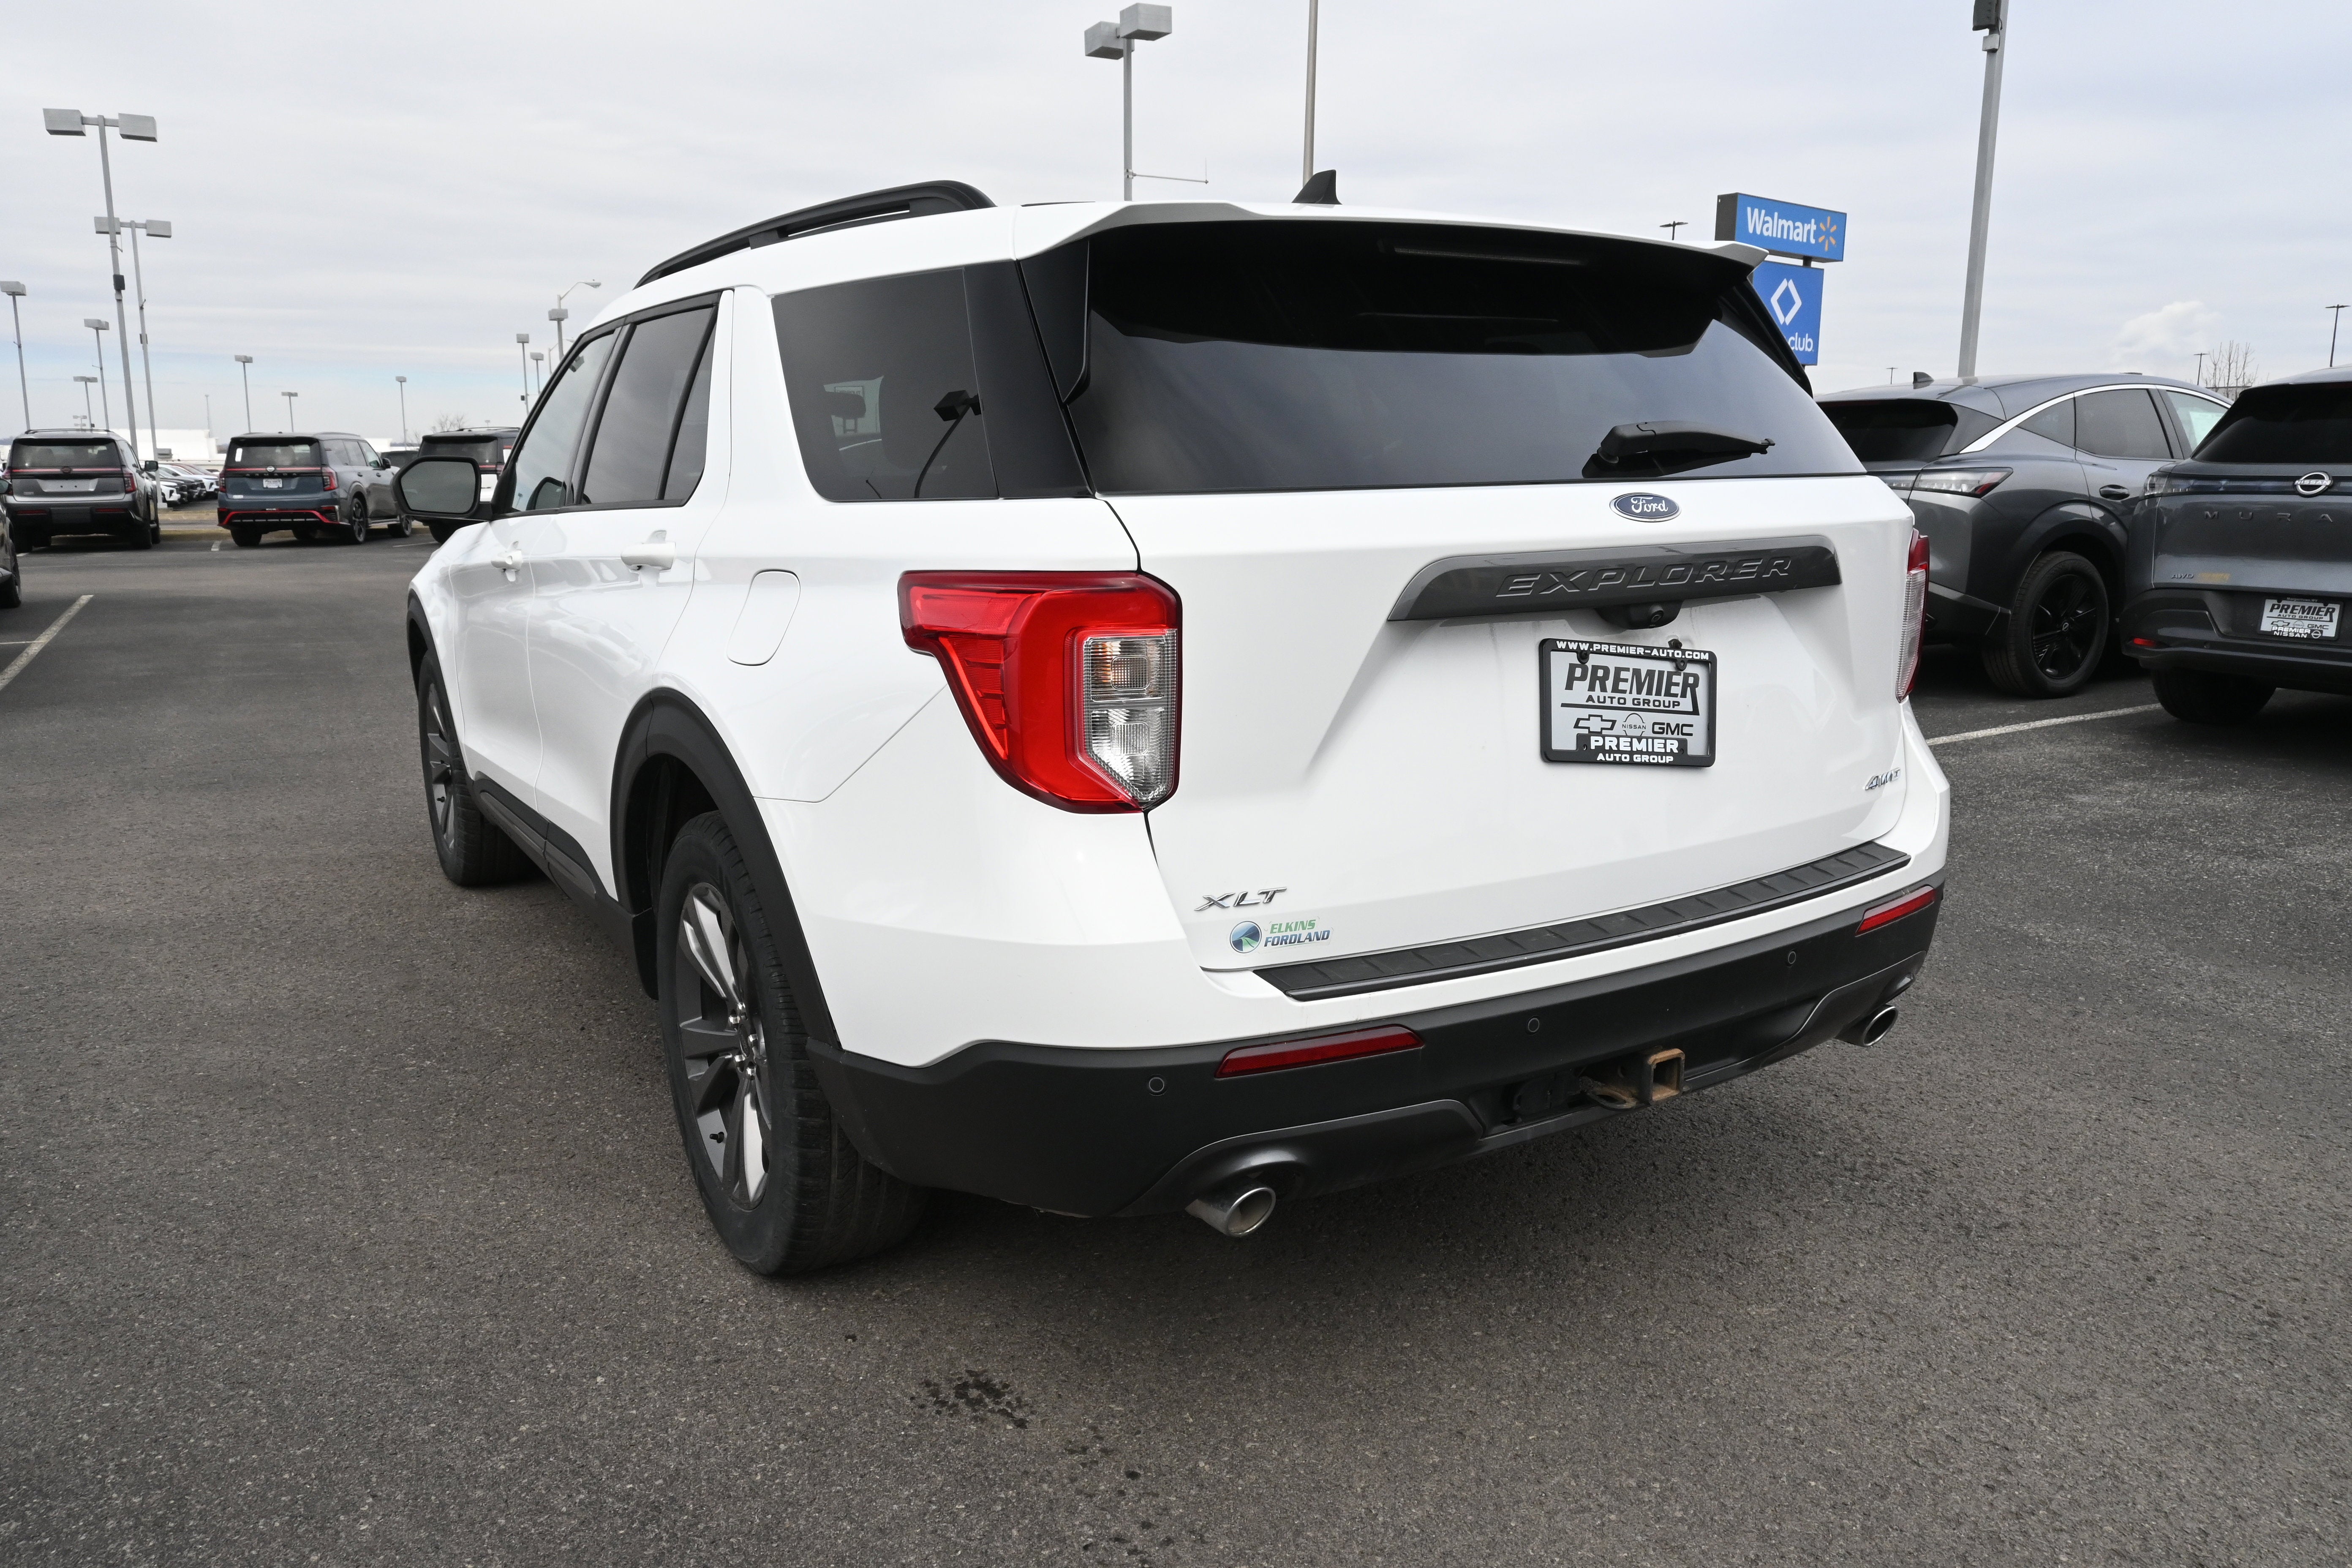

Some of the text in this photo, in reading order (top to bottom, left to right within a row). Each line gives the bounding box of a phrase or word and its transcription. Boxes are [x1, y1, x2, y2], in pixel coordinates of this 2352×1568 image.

[1747, 207, 1816, 244] Walmart
[1788, 332, 1813, 351] club
[1631, 497, 1668, 513] Ford
[1496, 556, 1791, 597] EXPLORER
[2269, 604, 2336, 618] PREMIER
[1556, 641, 1709, 660] WWW.PREMIER-AUTO.COM
[1565, 663, 1700, 701] PREMIER
[1586, 694, 1680, 708] AUTO GROUP
[1652, 721, 1693, 736] GMC
[1590, 736, 1678, 753] PREMIER
[1597, 753, 1674, 763] AUTO GROUP
[1194, 887, 1287, 911] XLT
[1270, 919, 1316, 934] ELKINS
[1264, 930, 1330, 947] FORDLAND
